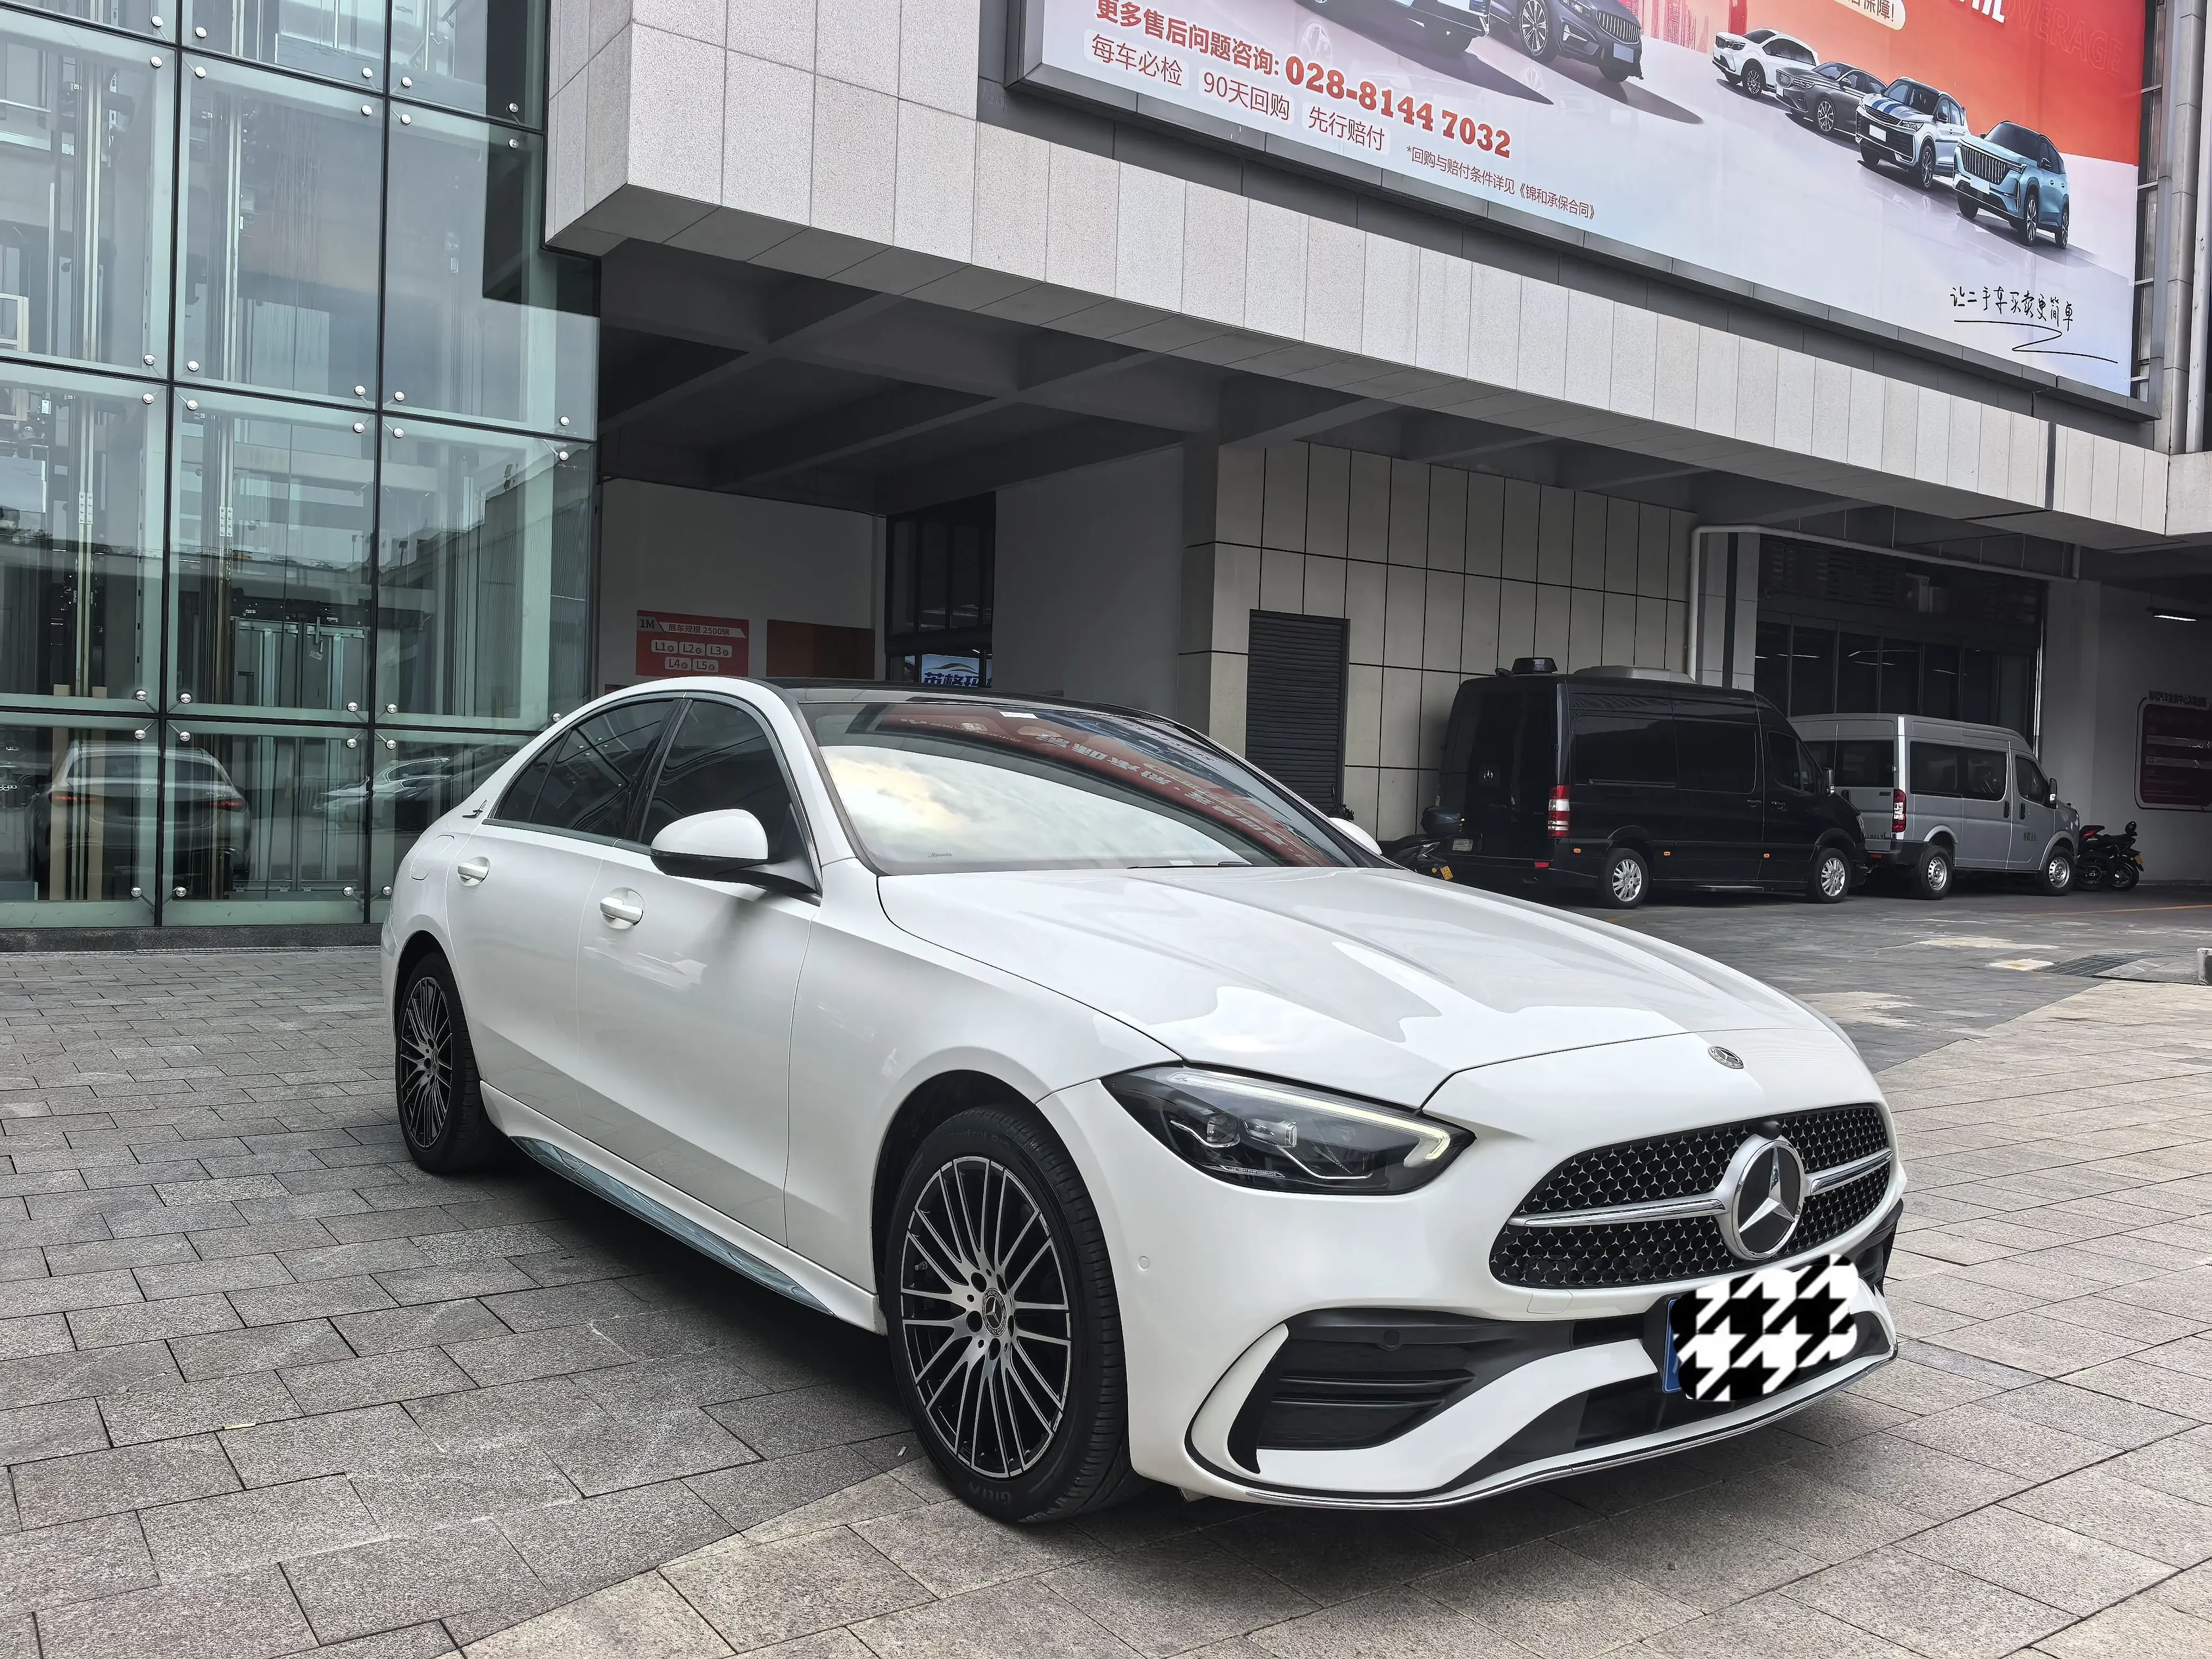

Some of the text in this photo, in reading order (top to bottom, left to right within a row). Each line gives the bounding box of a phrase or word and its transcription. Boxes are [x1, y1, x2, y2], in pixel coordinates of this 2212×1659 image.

[1092, 33, 1385, 151] 每车必检 90天回购 先行赔付
[1096, 0, 1510, 158] 更多售后问题咨询: 028-8144 7032
